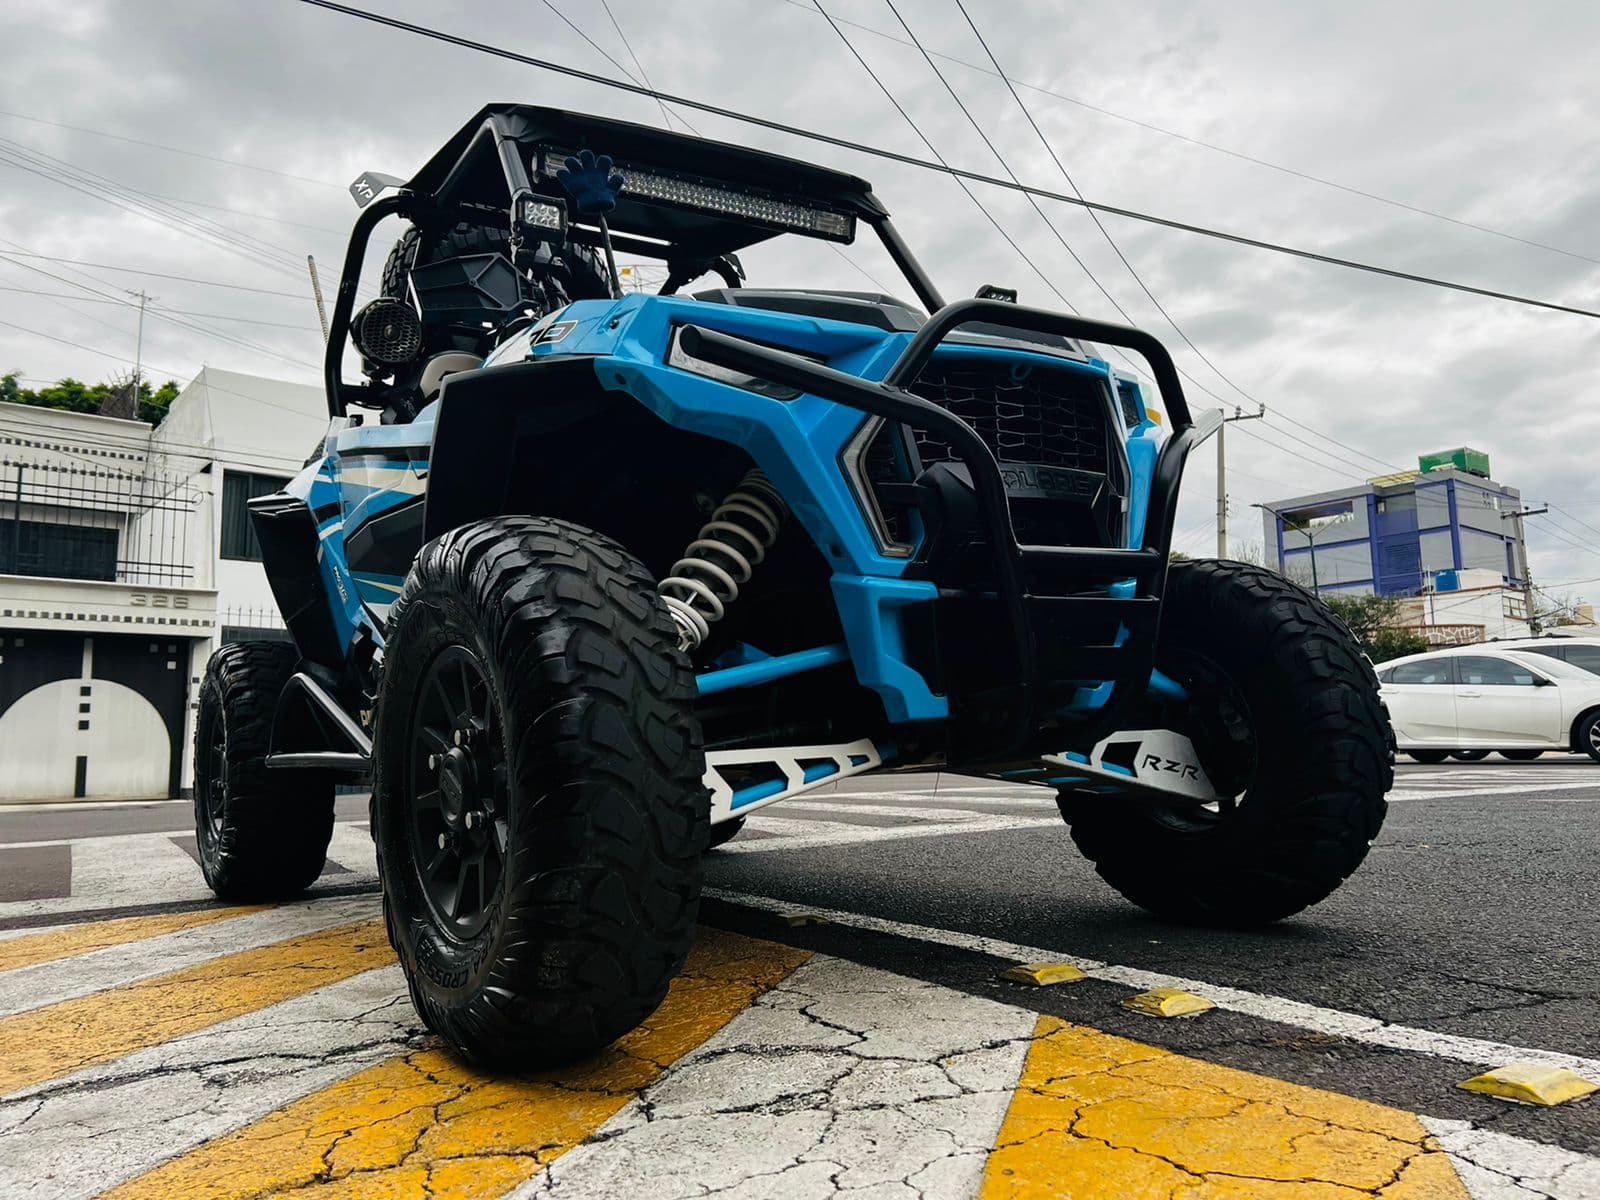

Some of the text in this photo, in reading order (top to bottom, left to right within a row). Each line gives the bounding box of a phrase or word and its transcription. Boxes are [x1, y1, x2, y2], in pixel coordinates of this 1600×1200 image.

[354, 179, 374, 199] XP
[1000, 468, 1091, 496] OLARIS
[1142, 754, 1199, 781] RZR
